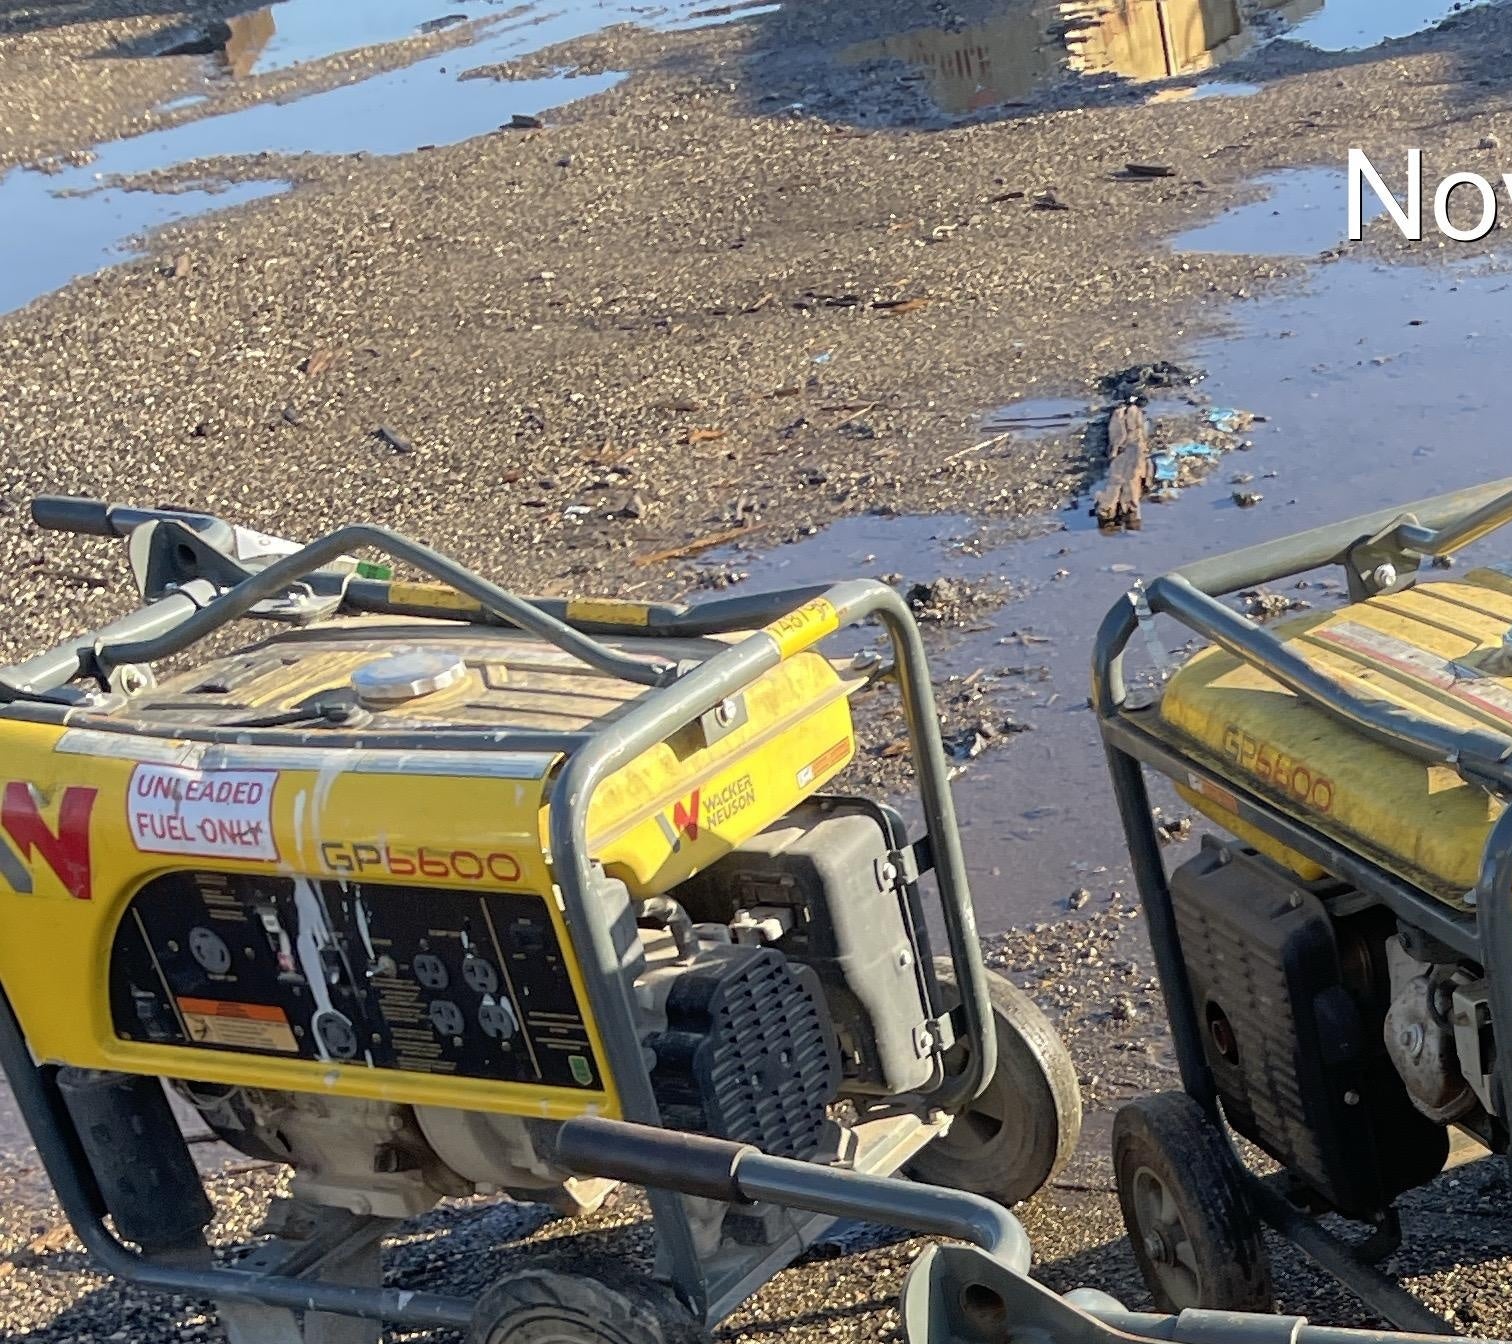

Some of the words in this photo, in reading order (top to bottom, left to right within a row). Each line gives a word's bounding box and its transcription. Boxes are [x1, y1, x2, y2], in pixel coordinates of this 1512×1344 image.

[1223, 722, 1333, 813] GP6600
[137, 774, 264, 805] UNLEADED
[702, 774, 753, 813] WACKER
[706, 787, 756, 831] NEUSON
[136, 812, 197, 841] FUEL
[197, 818, 262, 846] ONLY
[321, 842, 521, 881] GP6600
